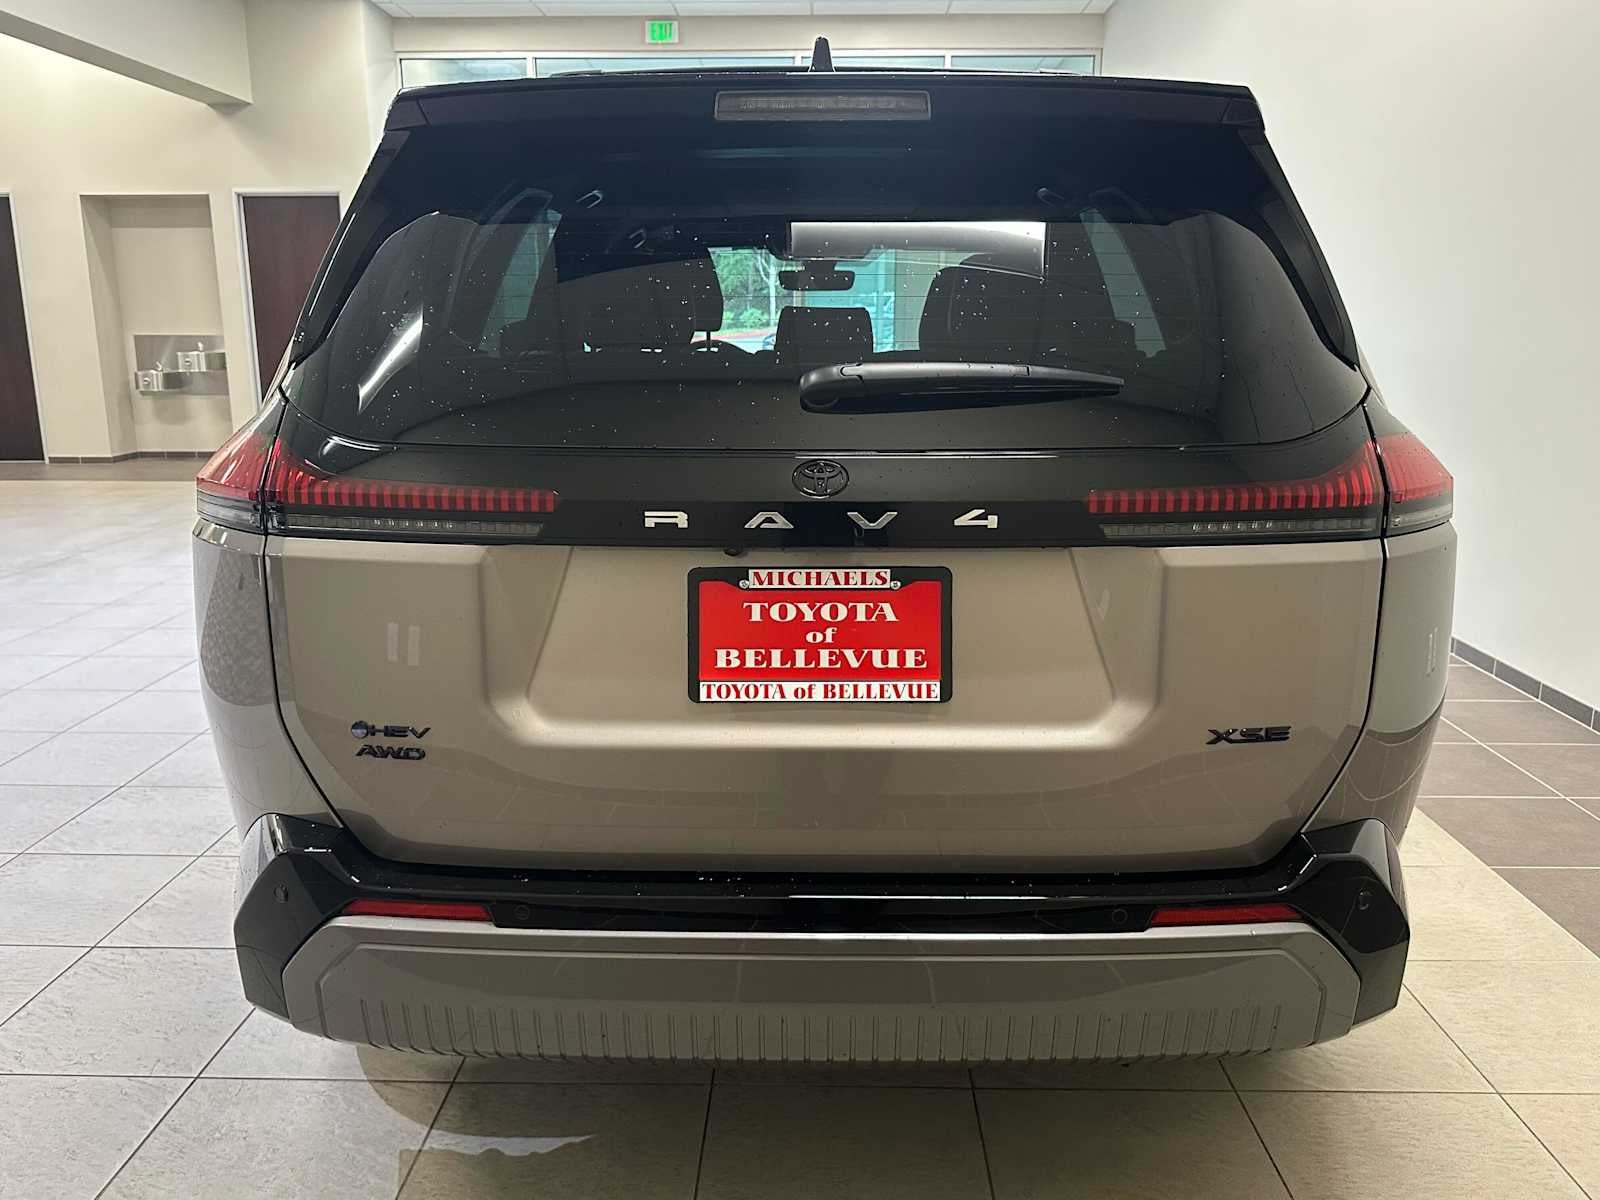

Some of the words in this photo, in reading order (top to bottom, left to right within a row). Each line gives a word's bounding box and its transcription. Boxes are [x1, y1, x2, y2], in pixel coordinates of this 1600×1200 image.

[752, 571, 888, 586] MICHAELS
[743, 602, 899, 622] TOYOTA
[805, 627, 838, 644] of
[714, 648, 928, 669] BELLEVUE
[702, 683, 787, 700] TOYOTA
[793, 683, 817, 700] of
[822, 683, 939, 700] BELLEVUE
[368, 724, 432, 739] HEV
[1205, 726, 1292, 745] XSE
[355, 744, 426, 761] AWD
